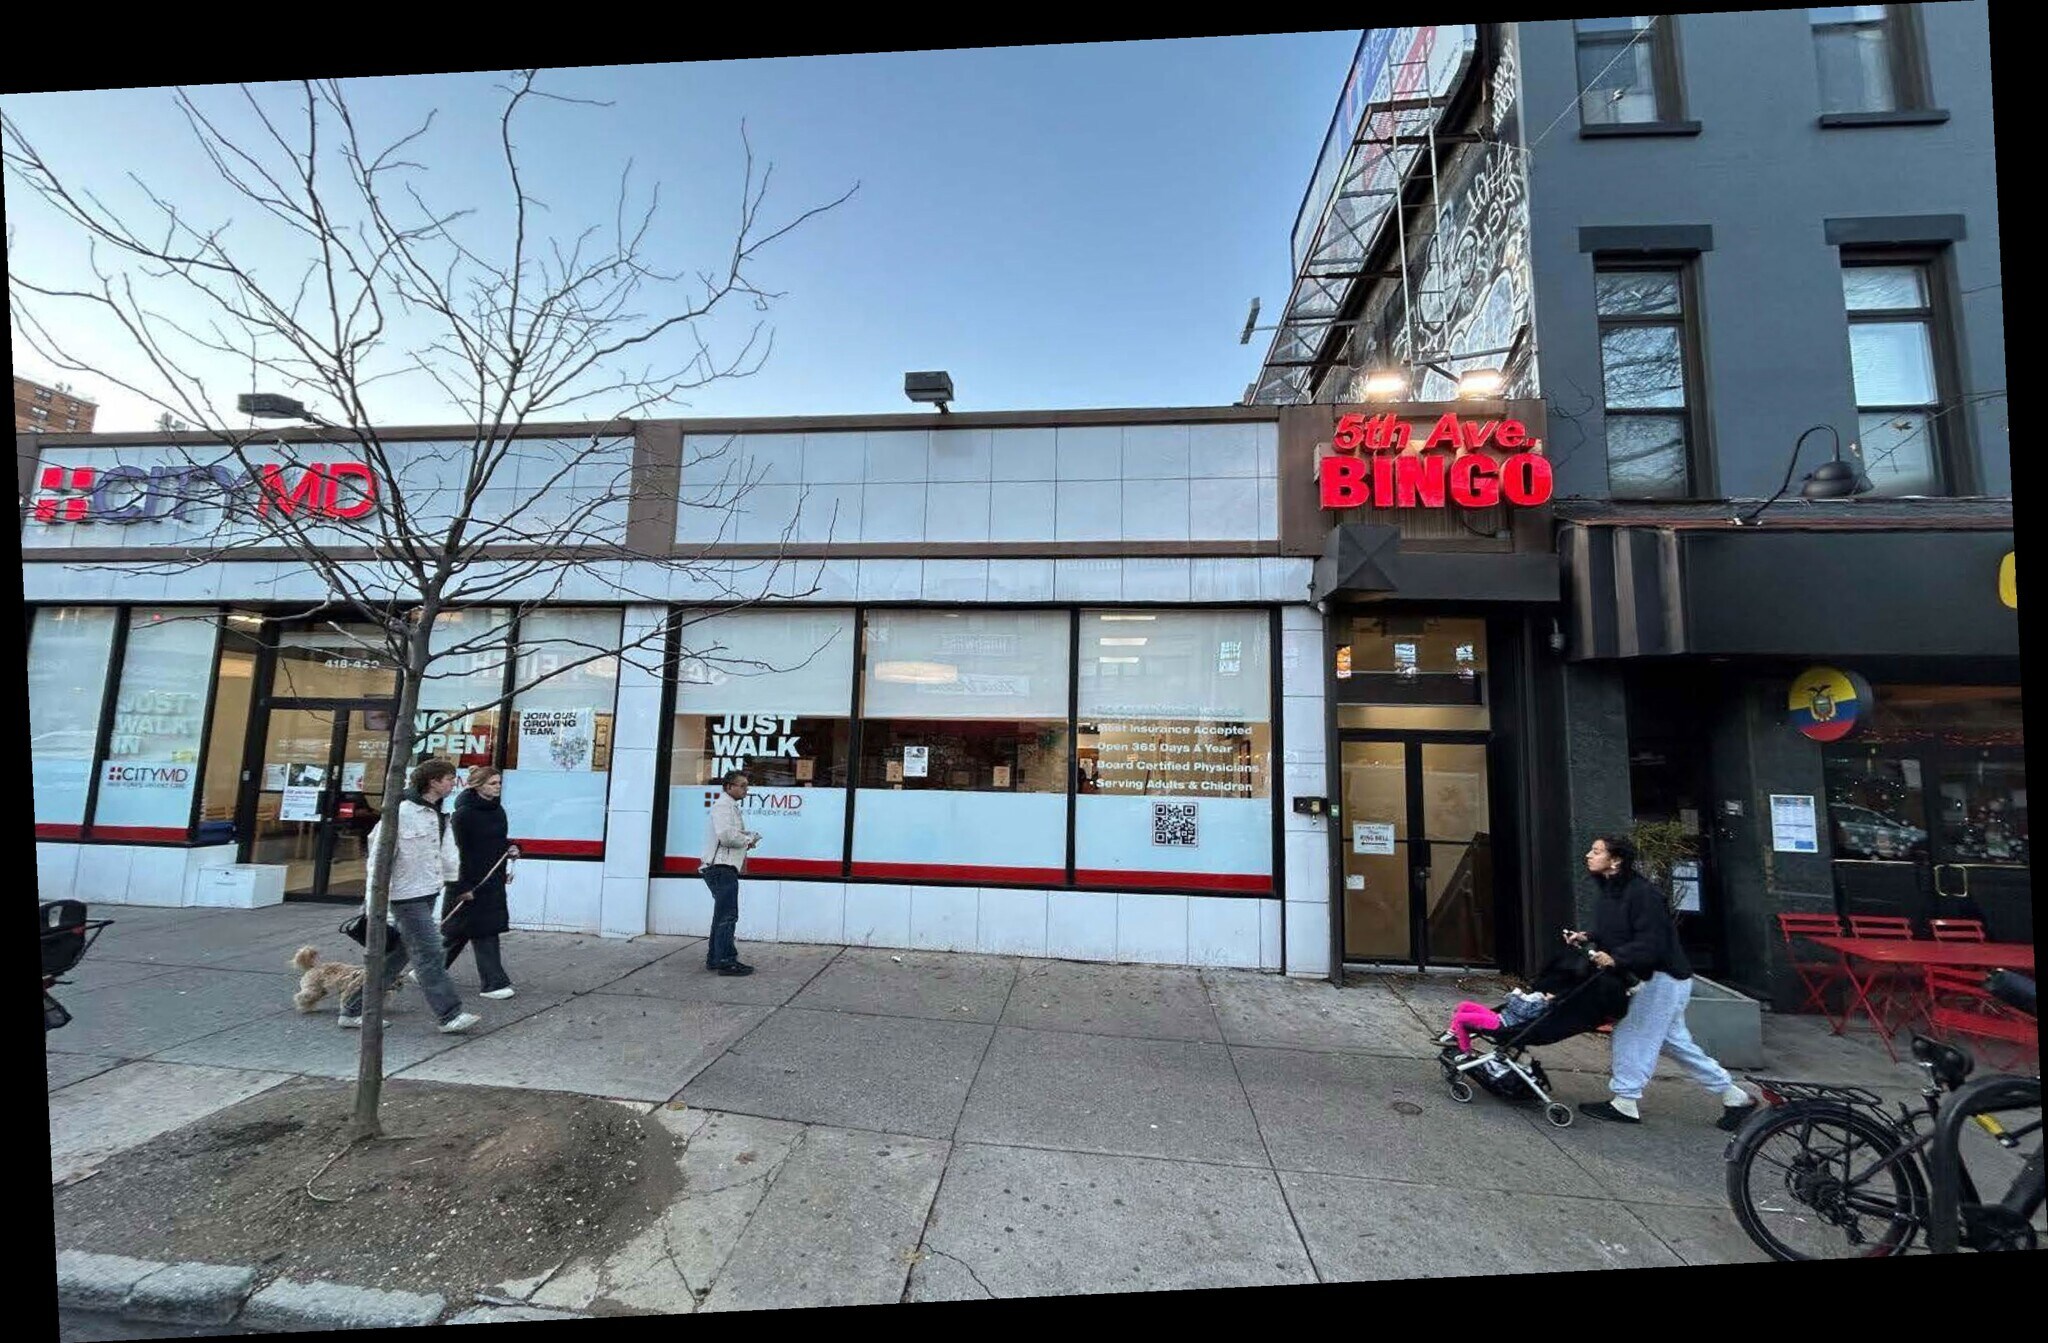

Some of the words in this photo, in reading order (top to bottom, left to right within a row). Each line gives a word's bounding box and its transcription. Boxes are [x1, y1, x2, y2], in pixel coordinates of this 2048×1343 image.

[1333, 412, 1412, 454] 5th
[1419, 412, 1537, 453] Ave.
[1320, 453, 1553, 509] BINGO
[93, 462, 379, 522] CITYMD
[523, 719, 577, 728] GROWING
[524, 712, 551, 720] JOIN
[553, 712, 577, 720] OUR
[712, 714, 797, 734] JUST
[523, 727, 556, 735] TEAM.
[1130, 724, 1191, 734] Insurance
[1193, 725, 1253, 737] Accepted
[712, 735, 800, 757] WALK
[1097, 742, 1128, 752] Open
[1132, 742, 1156, 752] 365
[1160, 743, 1190, 754] Days
[1193, 743, 1202, 752] A
[1204, 743, 1234, 753] Year
[711, 757, 744, 778] IN
[1096, 760, 1134, 770] Board
[1136, 760, 1190, 771] Certified
[1193, 761, 1260, 773] Physicians
[122, 767, 189, 783] CITYMD
[1096, 778, 1144, 790] Serving
[1146, 779, 1185, 790] Adults
[1188, 781, 1198, 790] &
[1200, 781, 1253, 791] Children
[740, 793, 803, 809] ITYMD
